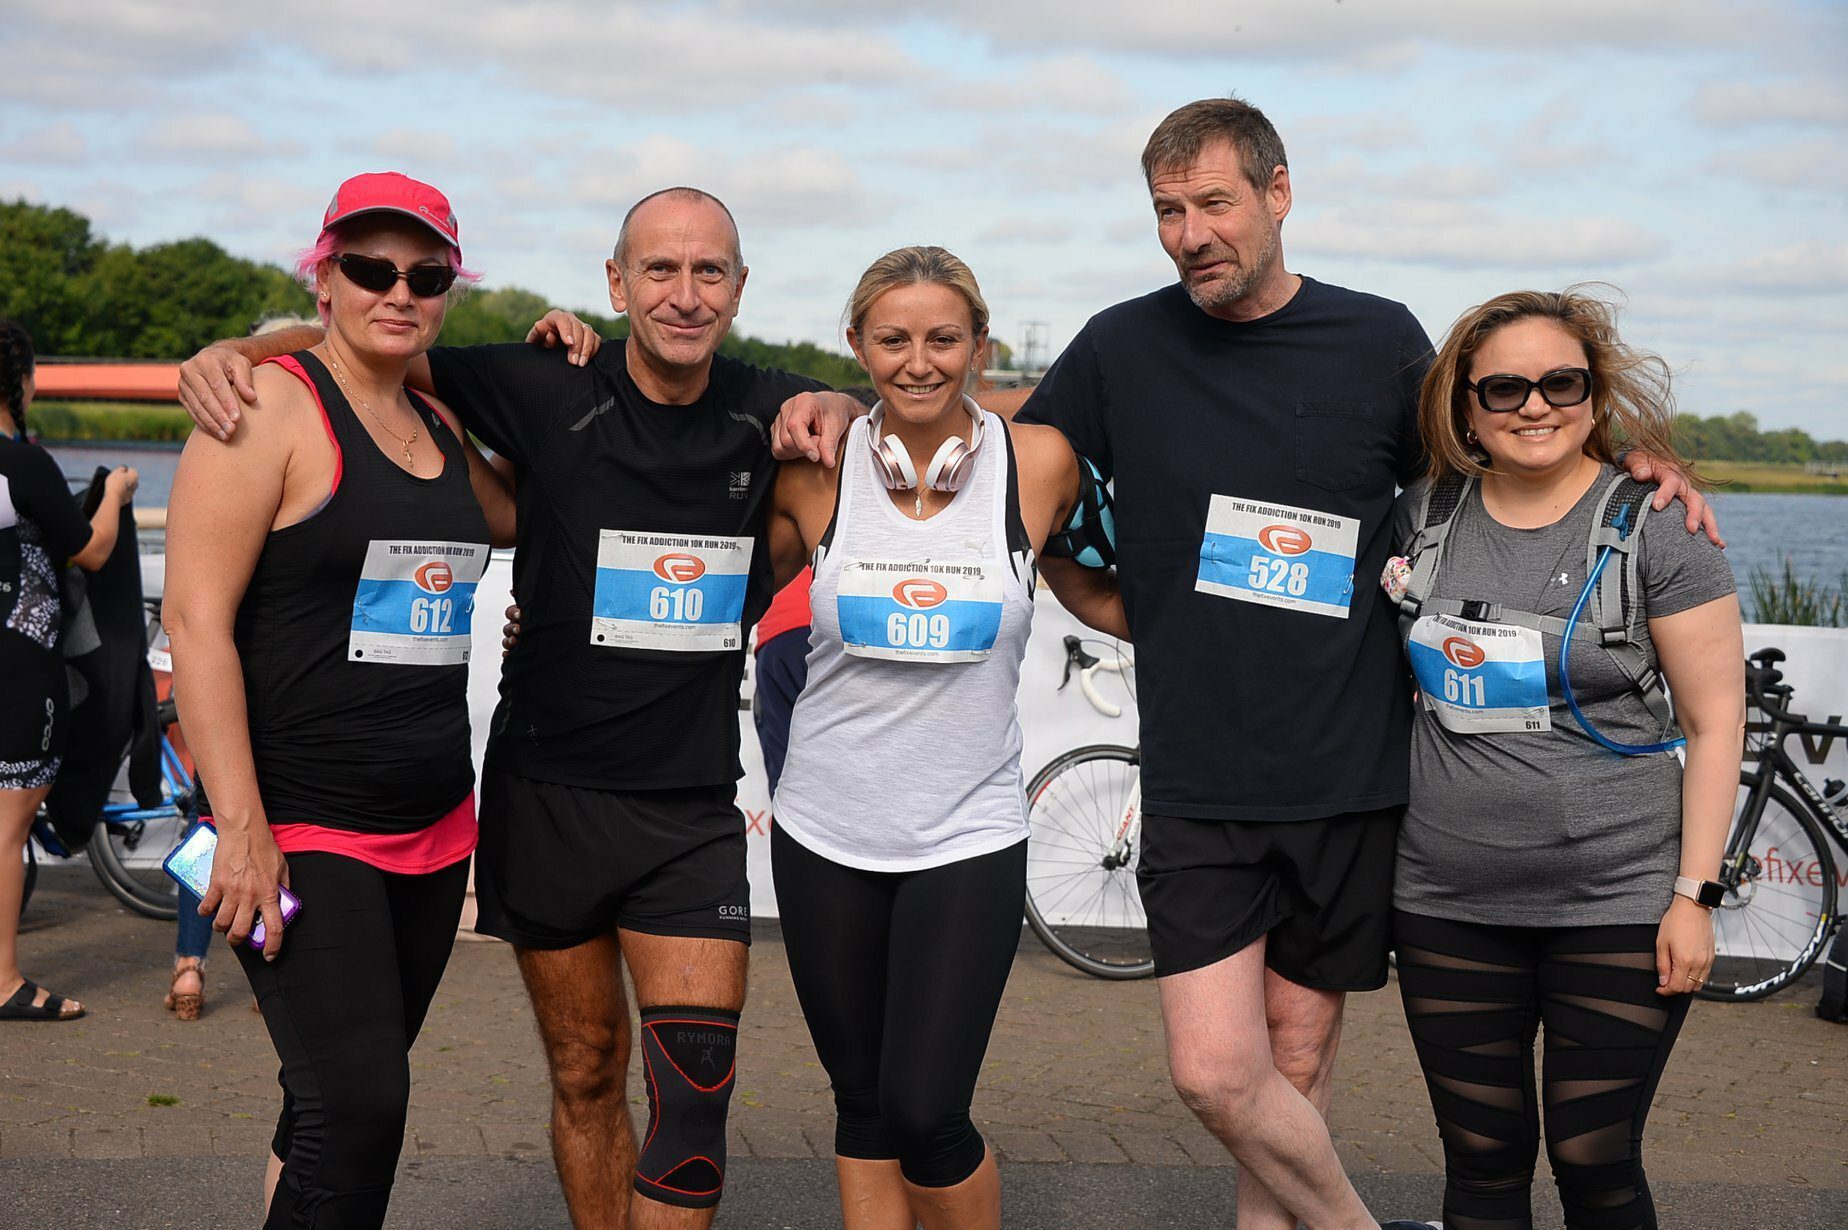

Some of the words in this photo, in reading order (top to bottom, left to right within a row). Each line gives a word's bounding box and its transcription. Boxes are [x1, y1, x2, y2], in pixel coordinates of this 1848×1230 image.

[1232, 502, 1245, 512] THE
[1246, 504, 1256, 514] FIX
[1257, 505, 1298, 521] ADDICTION
[1299, 513, 1312, 523] 10K
[1313, 515, 1326, 526] RUN
[1327, 518, 1342, 529] 2019
[622, 535, 635, 544] THE
[637, 536, 648, 545] FIX
[649, 537, 689, 547] ADDICTION
[690, 539, 703, 548] 10K
[704, 540, 718, 549] RUN
[720, 541, 737, 550] 2019
[389, 545, 401, 554] THE
[402, 545, 412, 554] FIX
[413, 546, 445, 555] ADDICTION
[463, 547, 475, 557] 2019
[861, 562, 874, 571] THE
[876, 563, 887, 571] FIX
[888, 563, 928, 573] ADDICTION
[930, 564, 944, 573] 10K
[946, 565, 961, 575] RUN
[962, 566, 981, 576] 2019
[1247, 555, 1309, 596] 528
[649, 586, 704, 621] 610
[409, 597, 452, 633] 612
[887, 612, 950, 648] 609
[1468, 625, 1481, 635] 10K
[1482, 627, 1497, 637] RUN
[1497, 628, 1517, 638] 2019
[723, 638, 736, 648] 610
[1444, 668, 1485, 706] 611
[1525, 721, 1540, 730] 611
[718, 905, 747, 917] GORE
[677, 1031, 731, 1046] RYMORA
